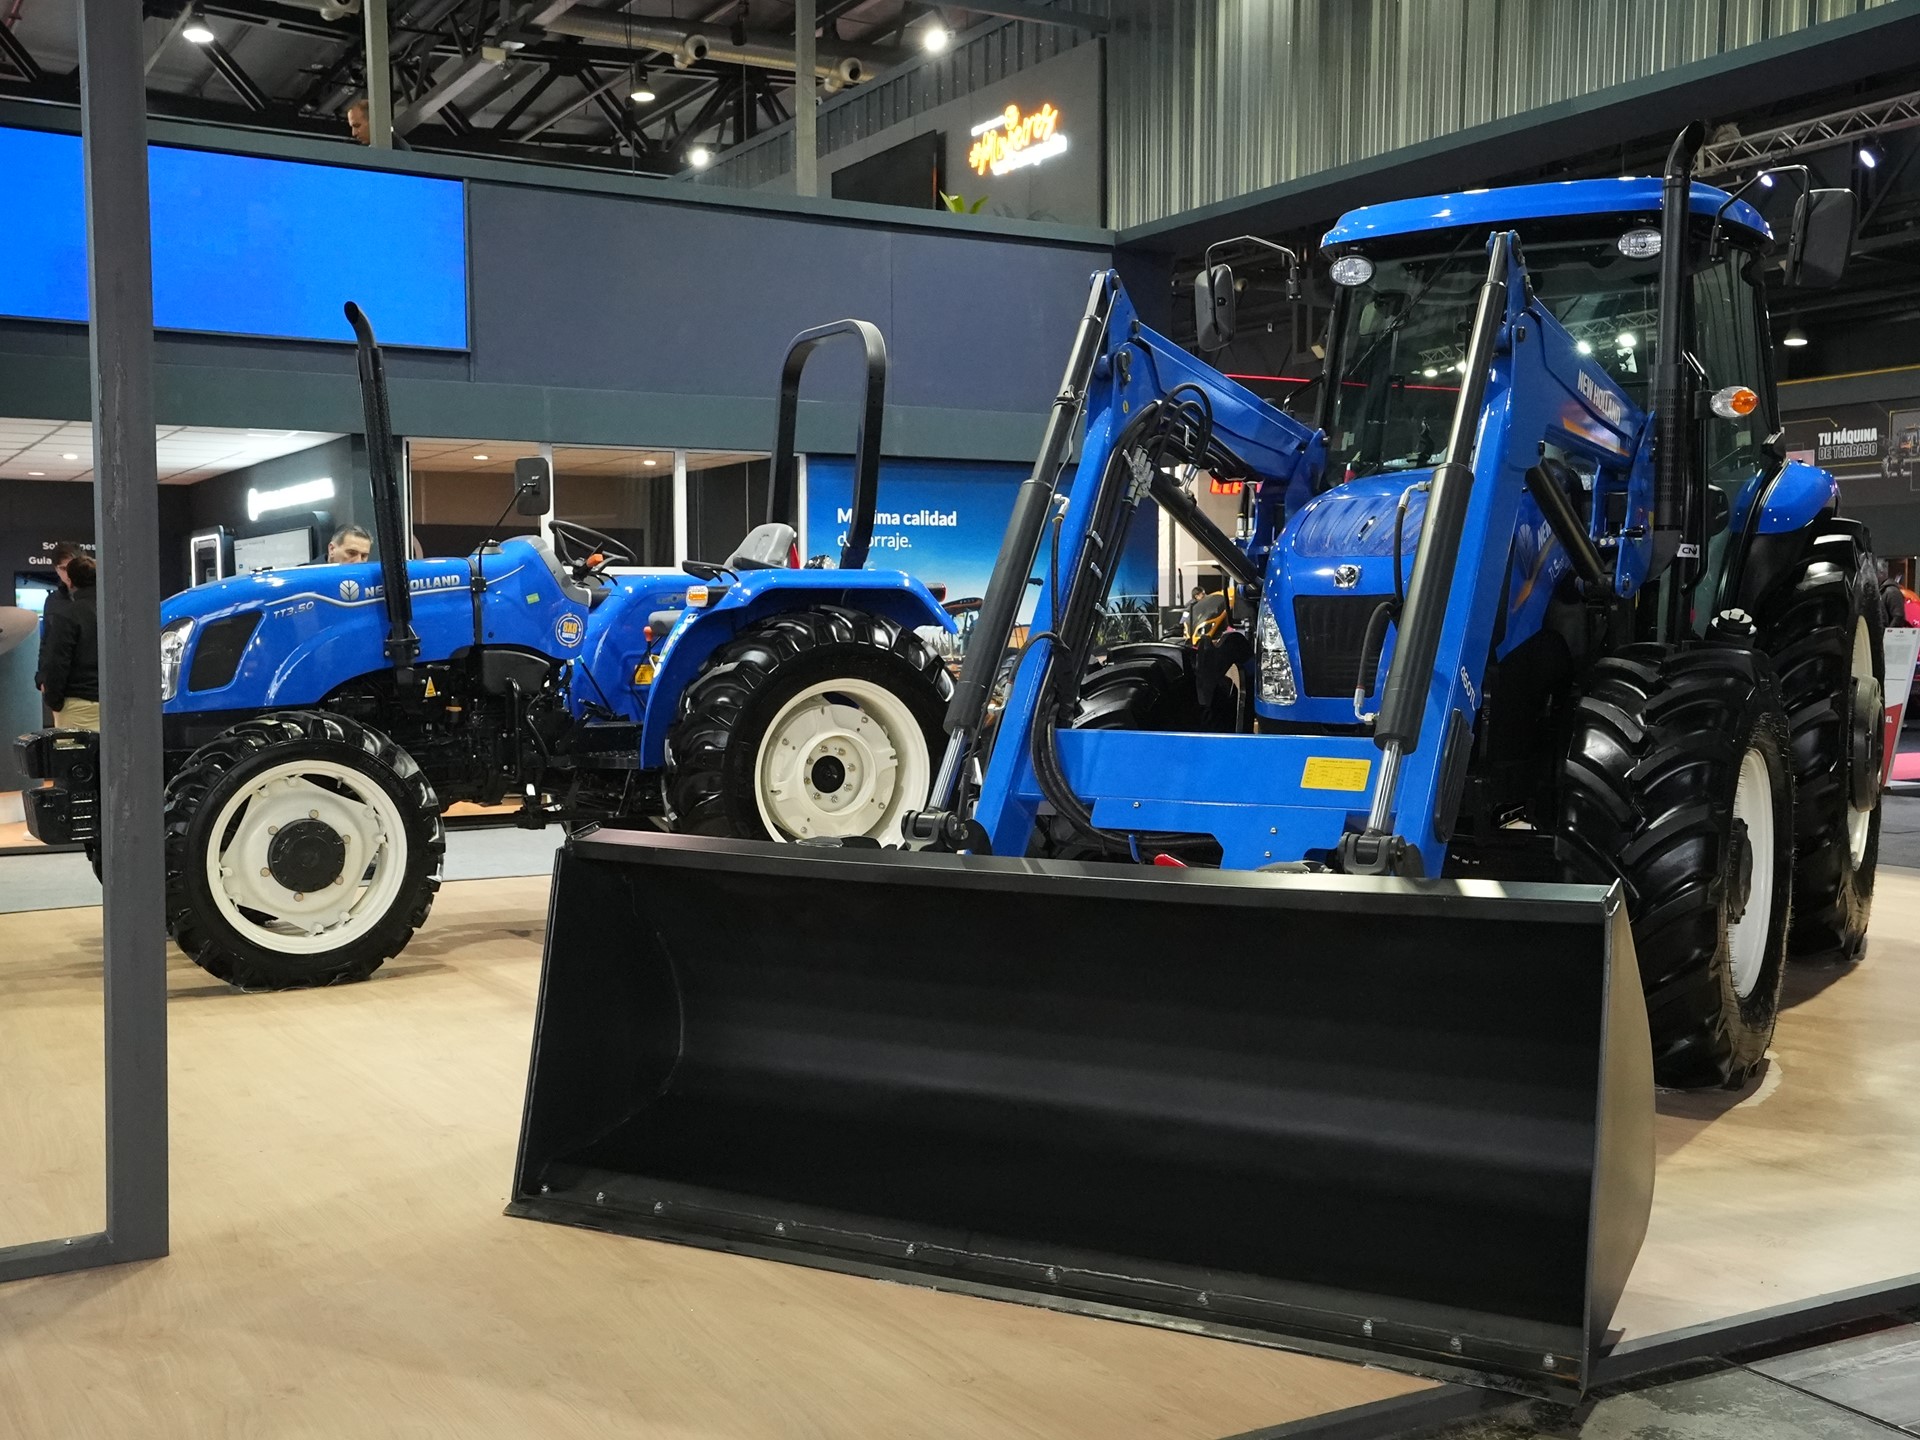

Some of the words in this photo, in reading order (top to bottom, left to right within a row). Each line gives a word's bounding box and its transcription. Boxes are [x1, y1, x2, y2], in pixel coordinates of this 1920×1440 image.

[1577, 368, 1594, 401] NEW
[1593, 383, 1621, 426] HOLLAND
[1818, 432, 1831, 446] TU
[1832, 427, 1878, 445] MÁQUINA
[1818, 446, 1832, 460] DE
[1833, 442, 1878, 459] TRABAJO
[836, 507, 900, 525] Mima
[902, 509, 957, 527] calidad
[364, 587, 384, 598] NE
[410, 574, 461, 590] OLLAND
[273, 601, 315, 619] TT3.50
